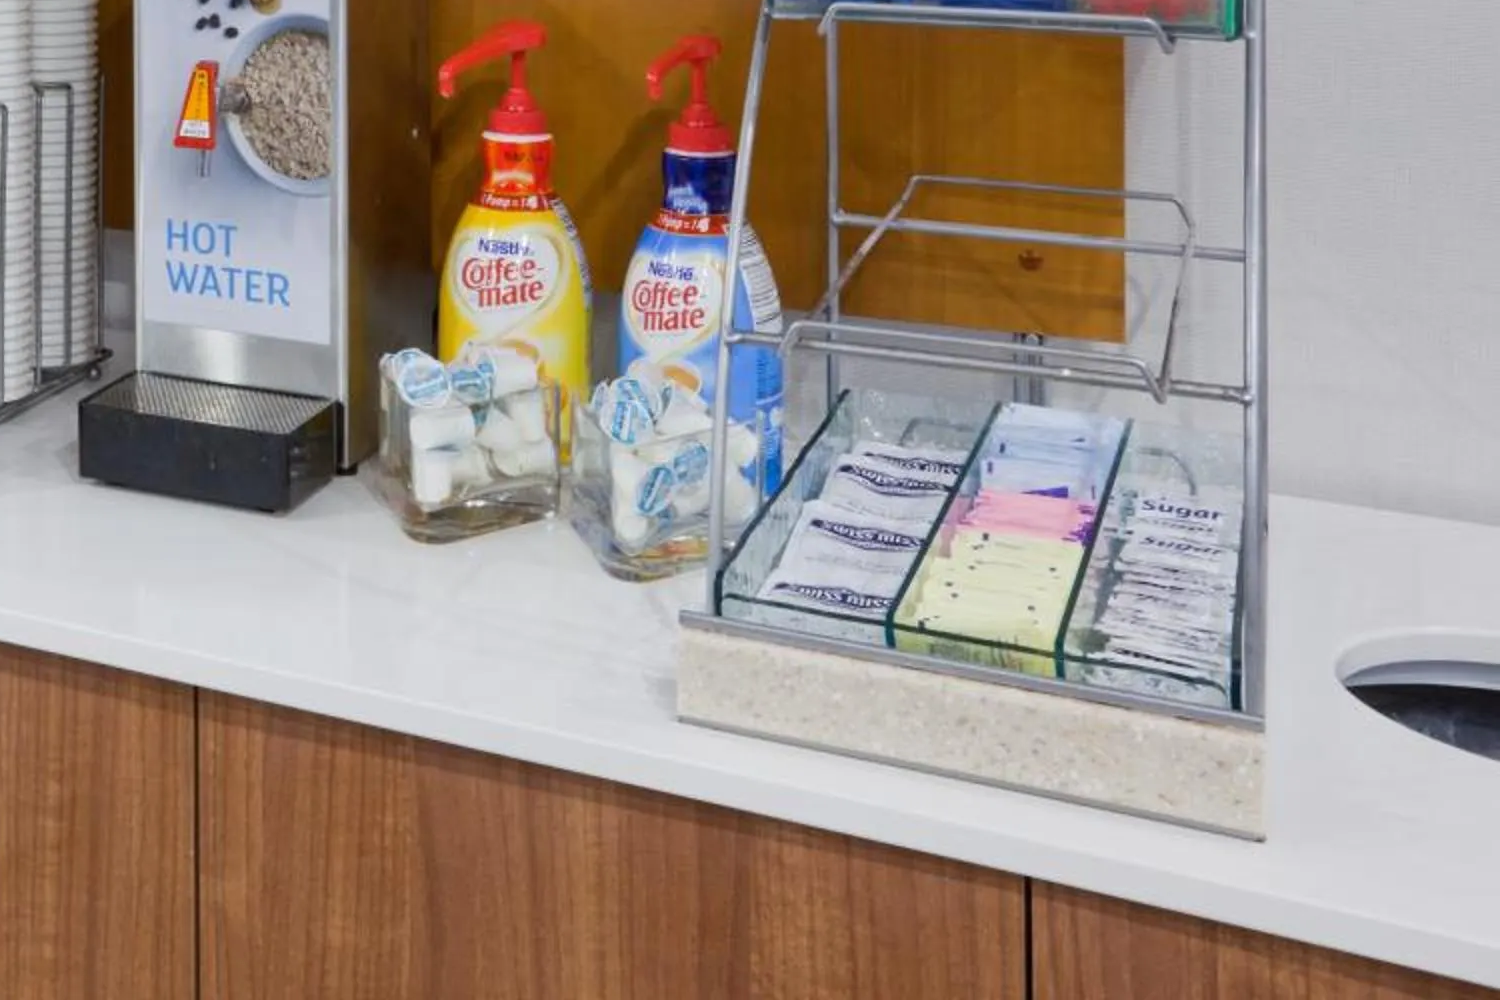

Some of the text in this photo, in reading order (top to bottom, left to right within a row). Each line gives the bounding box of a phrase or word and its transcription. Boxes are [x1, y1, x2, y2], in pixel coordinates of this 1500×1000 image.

[166, 218, 238, 258] HOT
[166, 260, 290, 307] WATER
[478, 281, 544, 308] mate
[643, 307, 705, 332] mate
[1141, 499, 1224, 521] Sugar
